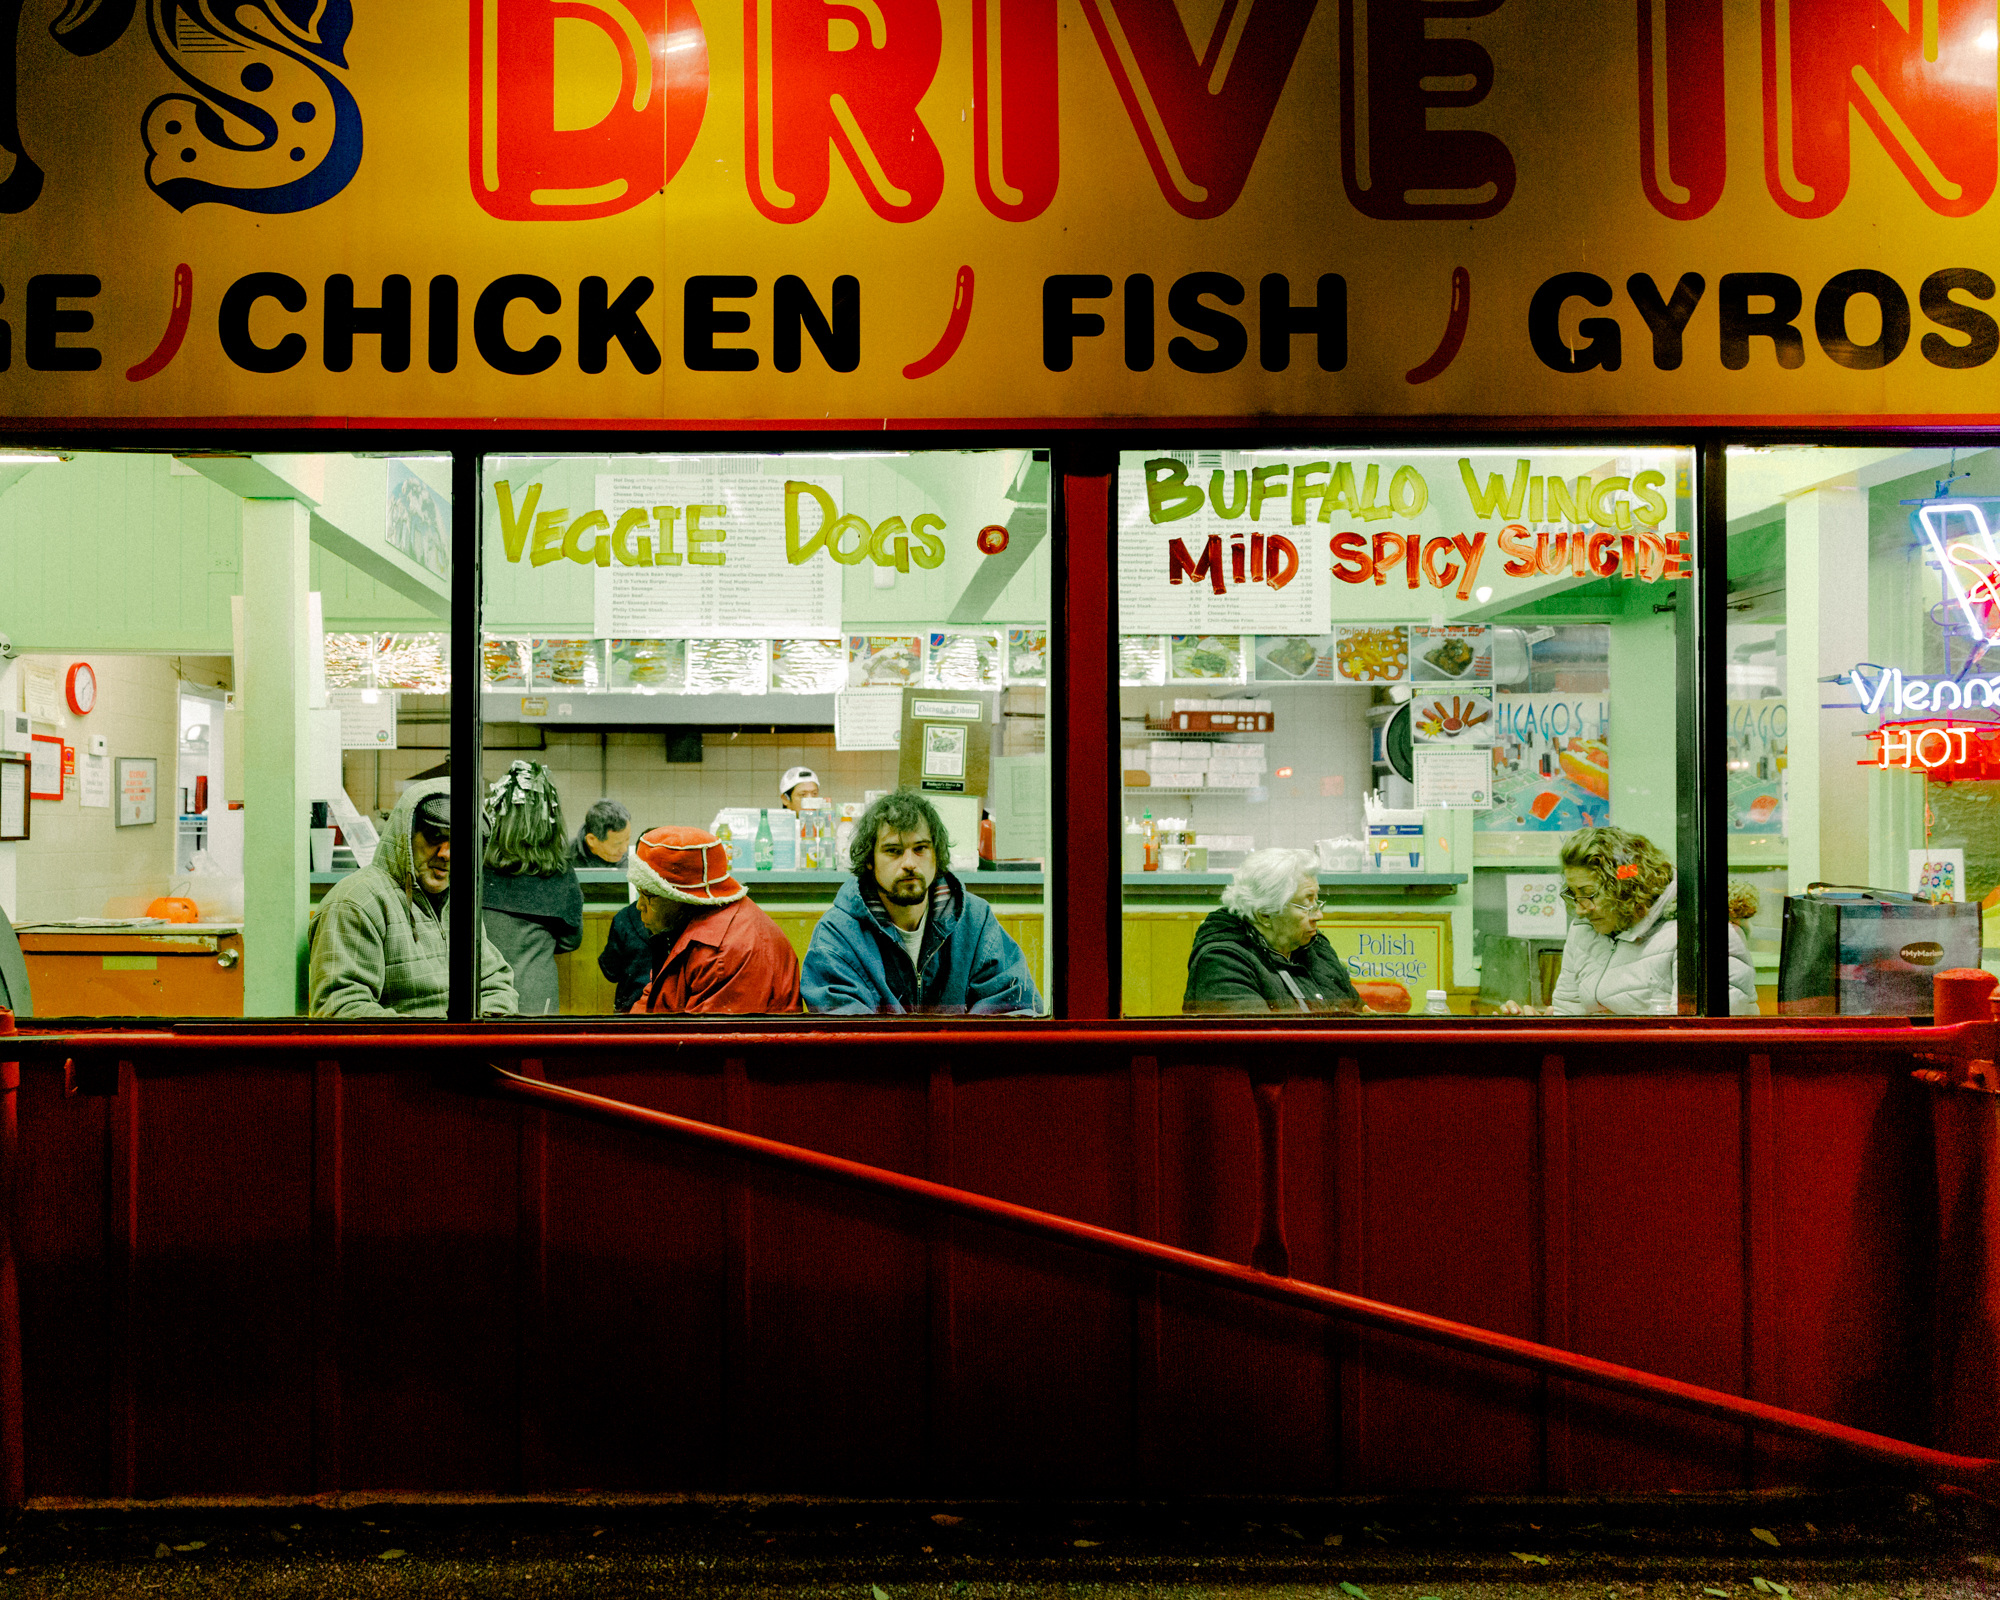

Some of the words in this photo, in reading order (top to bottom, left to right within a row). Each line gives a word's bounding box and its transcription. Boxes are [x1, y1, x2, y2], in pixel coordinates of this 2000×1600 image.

[470, 0, 1517, 224] DRIVE
[1637, 0, 2000, 221] IN
[0, 273, 102, 373] E
[218, 273, 861, 375] CHICKEN
[1042, 271, 1348, 374] FISH
[1528, 268, 2000, 373] GYROS
[494, 479, 728, 568] VEGGIE
[785, 480, 947, 574] DOGS
[1144, 458, 1429, 526] BUFFALO
[1458, 458, 1668, 531] WINGS
[1330, 531, 1488, 601] SPICY
[1497, 524, 1693, 583] SUICIDE
[1339, 628, 1366, 636] Onion
[916, 704, 943, 715] Chicago
[951, 705, 978, 715] Tribune
[1879, 727, 1977, 770] HOT
[1347, 955, 1427, 985] Sausage
[1358, 933, 1416, 956] Polish
